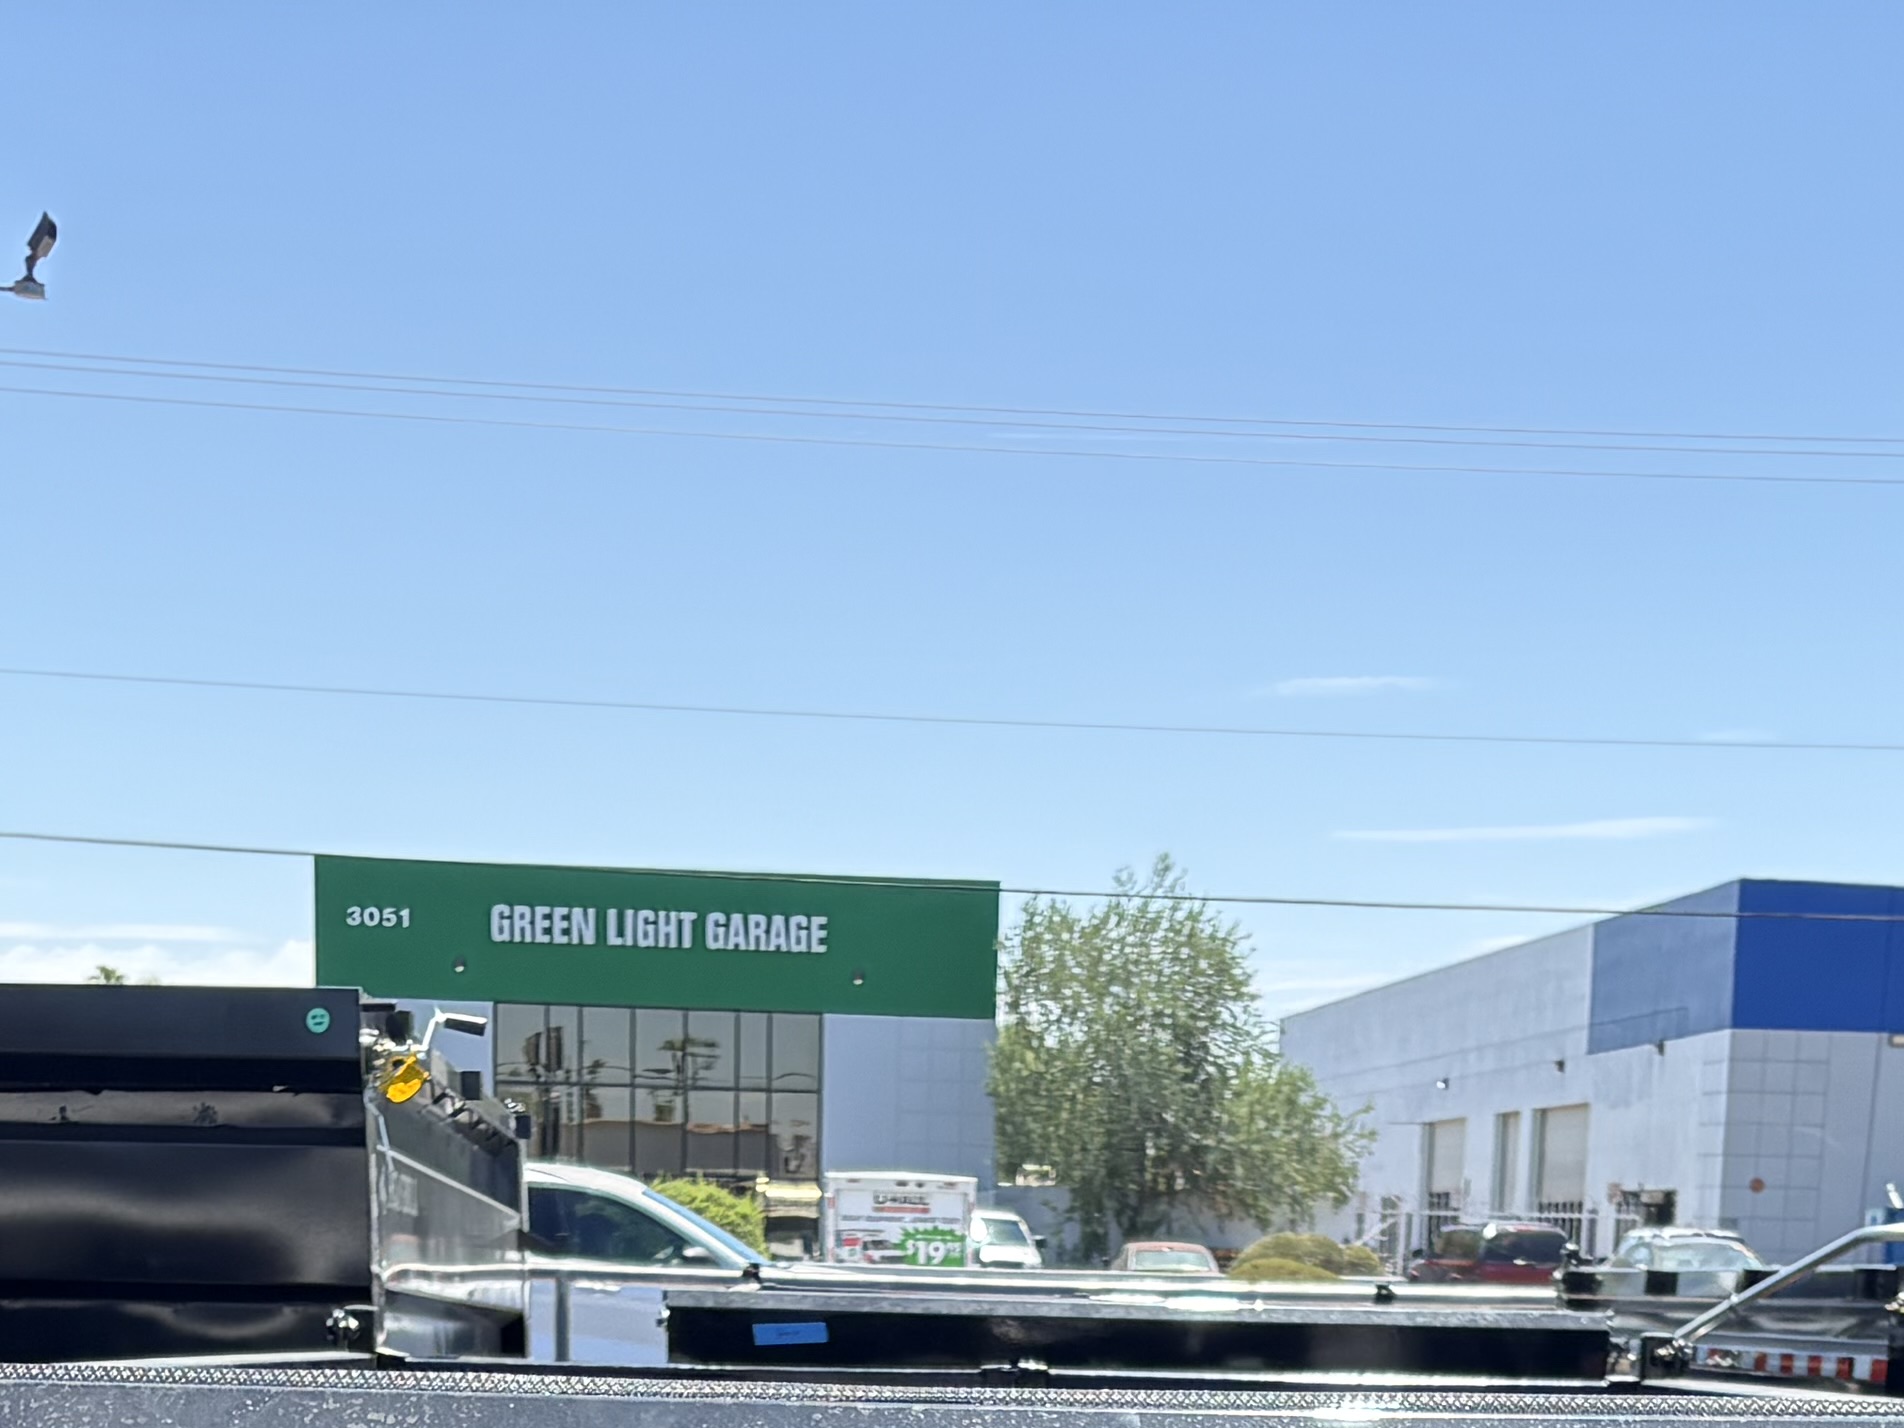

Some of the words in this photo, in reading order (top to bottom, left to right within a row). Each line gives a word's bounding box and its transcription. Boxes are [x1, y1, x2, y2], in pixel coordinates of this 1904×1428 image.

[346, 905, 411, 929] 3051
[490, 904, 596, 947] GREEN
[606, 907, 696, 950] LIGHT
[705, 911, 829, 954] GARAGE
